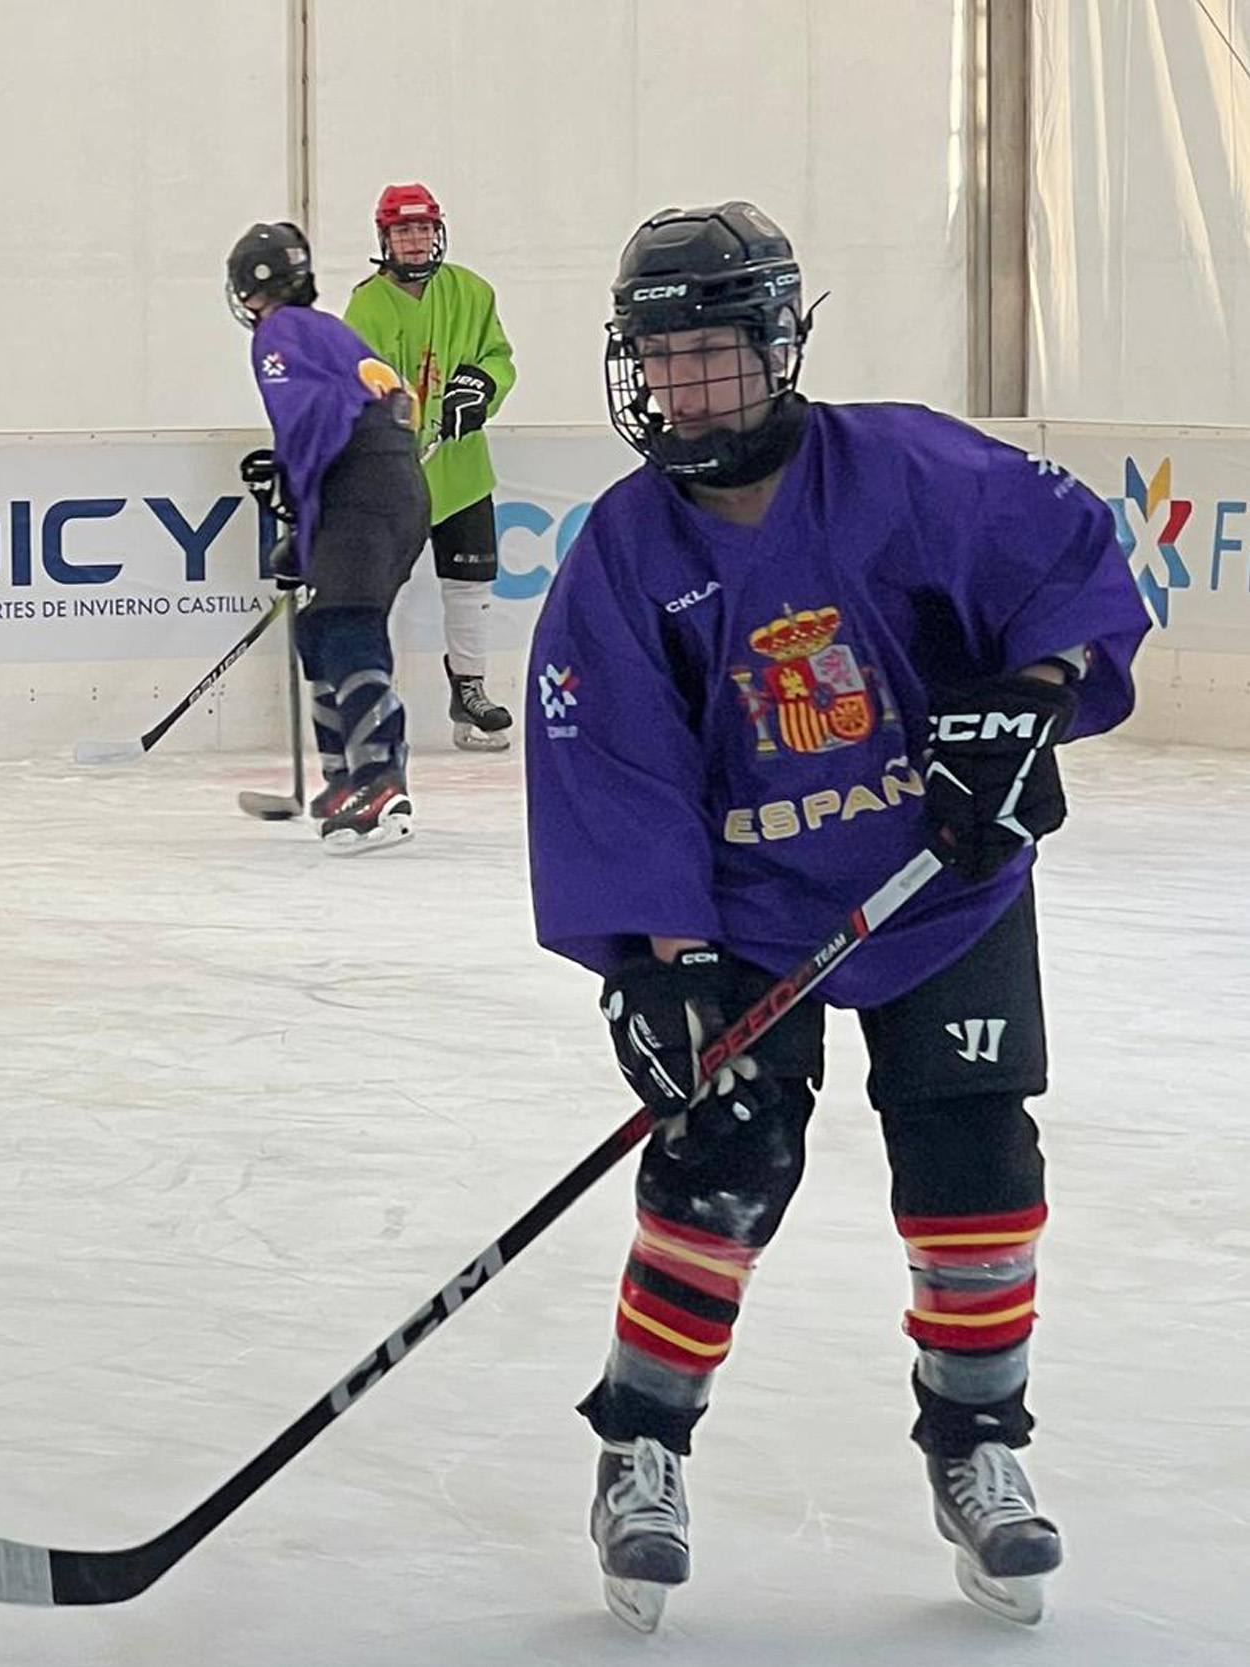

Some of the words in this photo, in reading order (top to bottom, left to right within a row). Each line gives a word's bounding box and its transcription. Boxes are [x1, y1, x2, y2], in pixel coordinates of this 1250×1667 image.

[632, 284, 688, 302] CCM
[42, 601, 68, 618] DE
[73, 598, 170, 617] INVIERNO
[177, 596, 263, 615] CASTILLA
[330, 1241, 505, 1414] CCM
